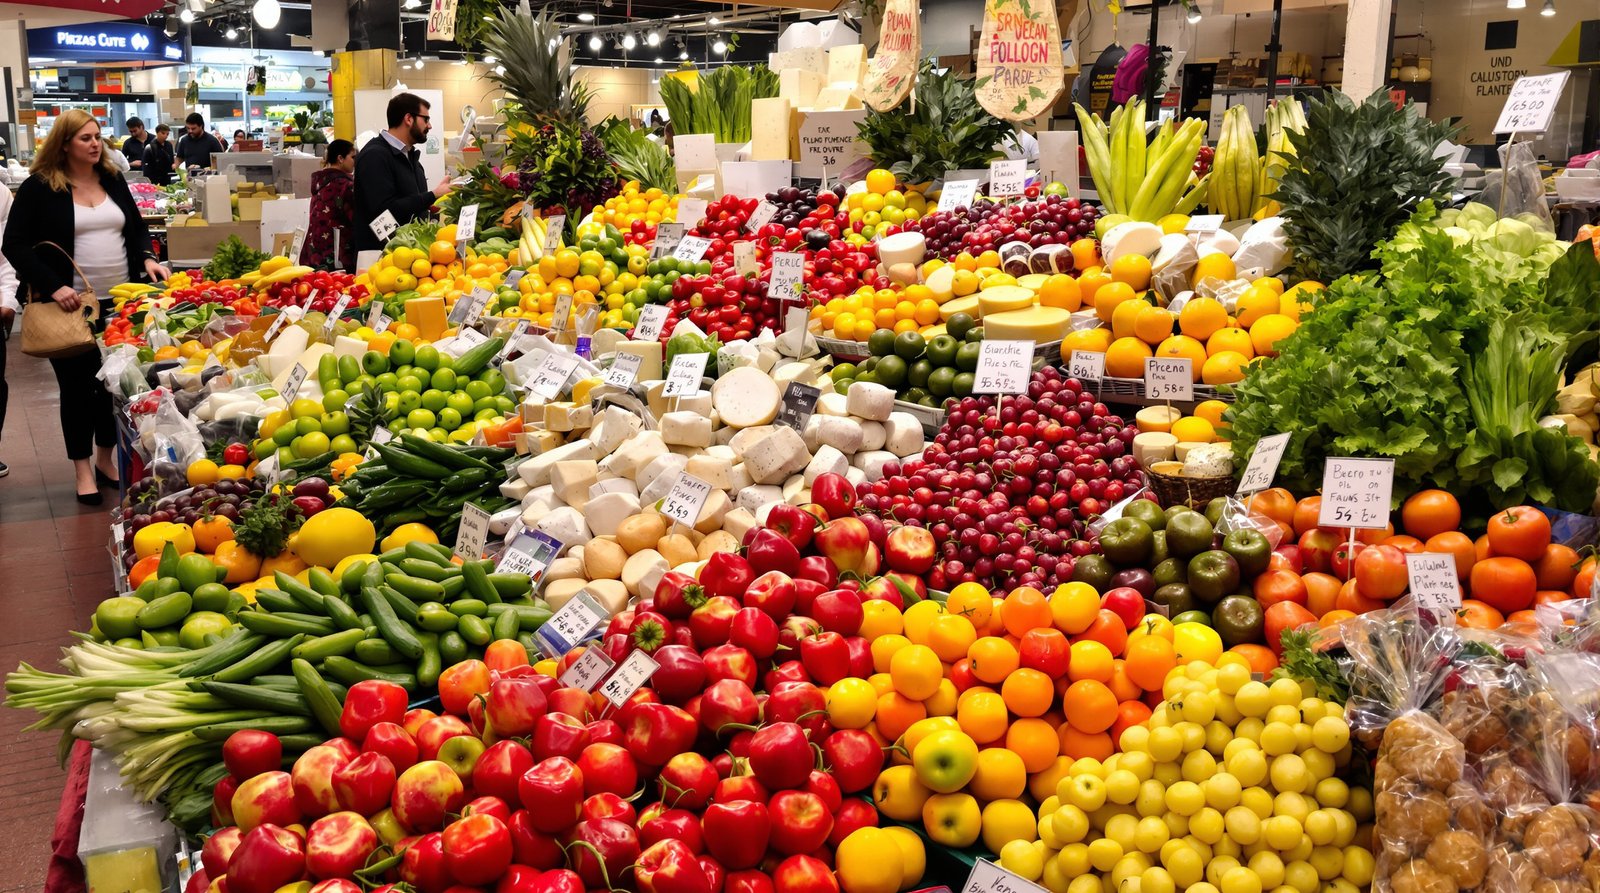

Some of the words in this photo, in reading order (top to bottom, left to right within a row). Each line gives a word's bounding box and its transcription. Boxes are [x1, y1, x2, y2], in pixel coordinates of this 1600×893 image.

[98, 33, 127, 47] CUTE
[990, 41, 1049, 63] FOLLOGN
[1491, 56, 1512, 68] UND
[822, 155, 836, 165] 3.6
